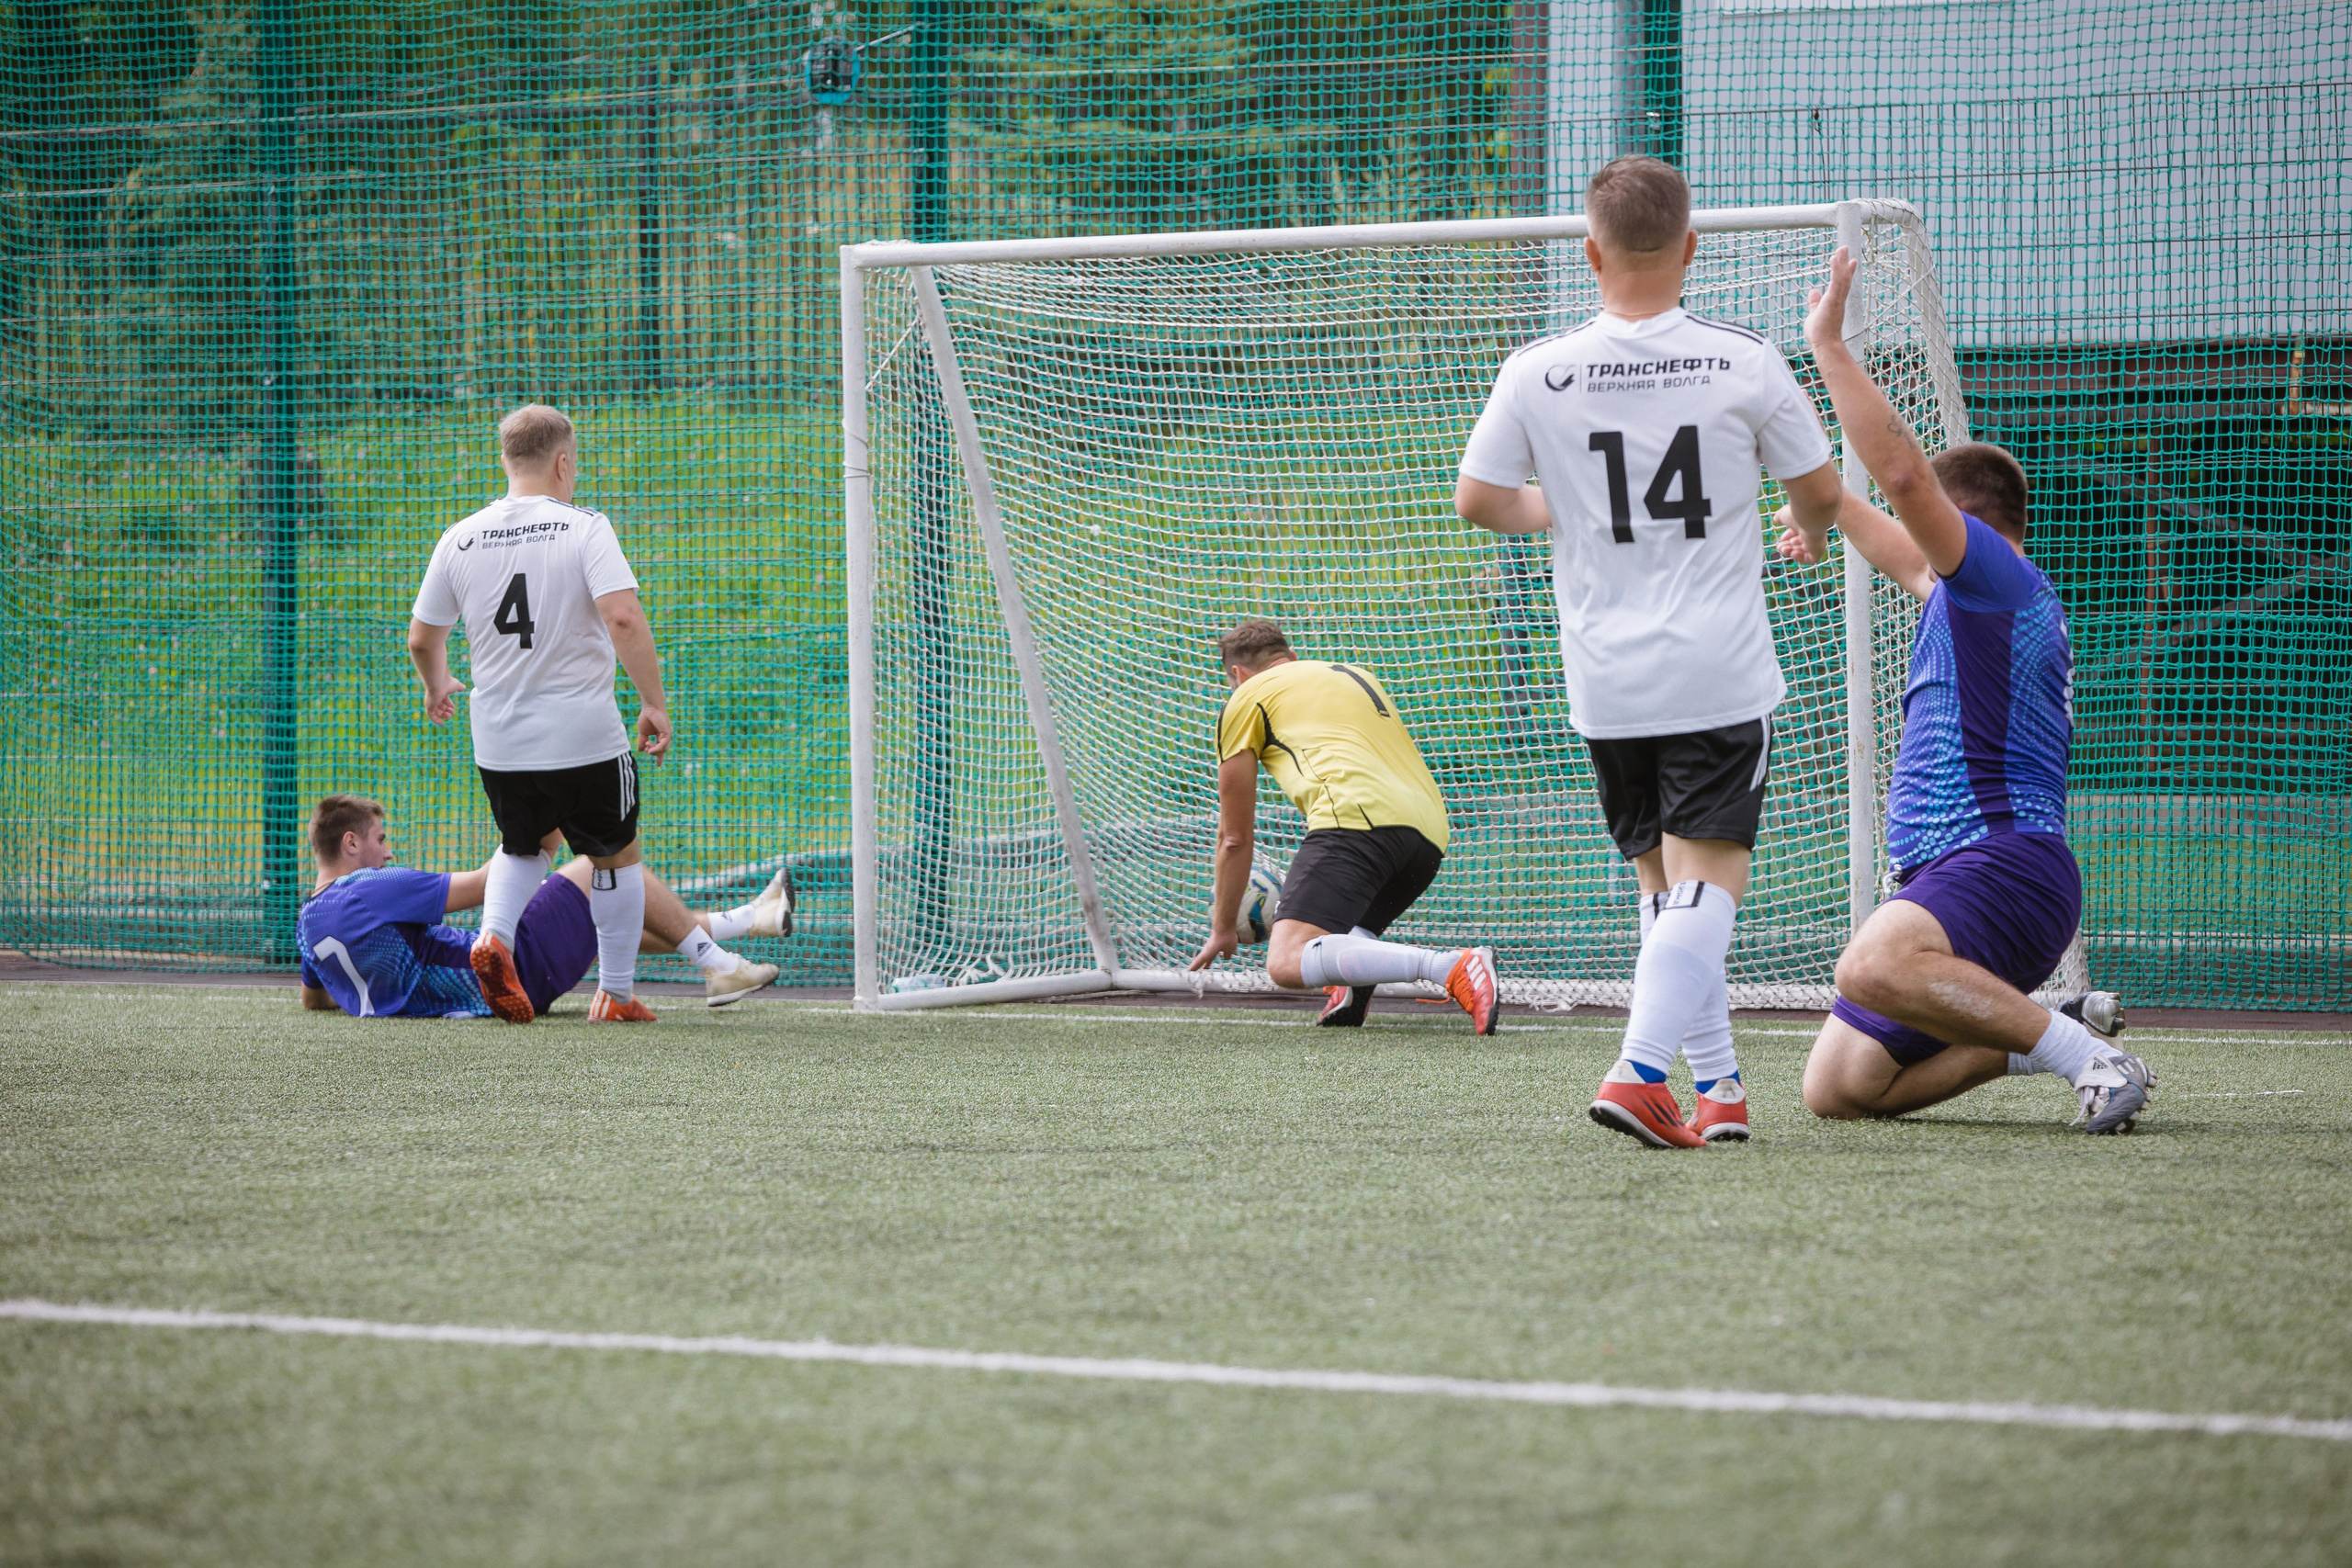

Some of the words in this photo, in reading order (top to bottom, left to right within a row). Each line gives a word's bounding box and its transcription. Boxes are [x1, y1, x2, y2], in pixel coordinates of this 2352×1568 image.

[1587, 357, 1731, 378] ТРАНСНЕФТЬ
[1588, 379, 1656, 393] ВЕРХНЯЯ
[1663, 375, 1712, 389] ВОЛГА
[1589, 424, 1712, 543] 14
[481, 522, 570, 540] ТРАНСНЕФТЬ
[526, 534, 556, 544] ВОЛГА
[493, 572, 535, 649] 4
